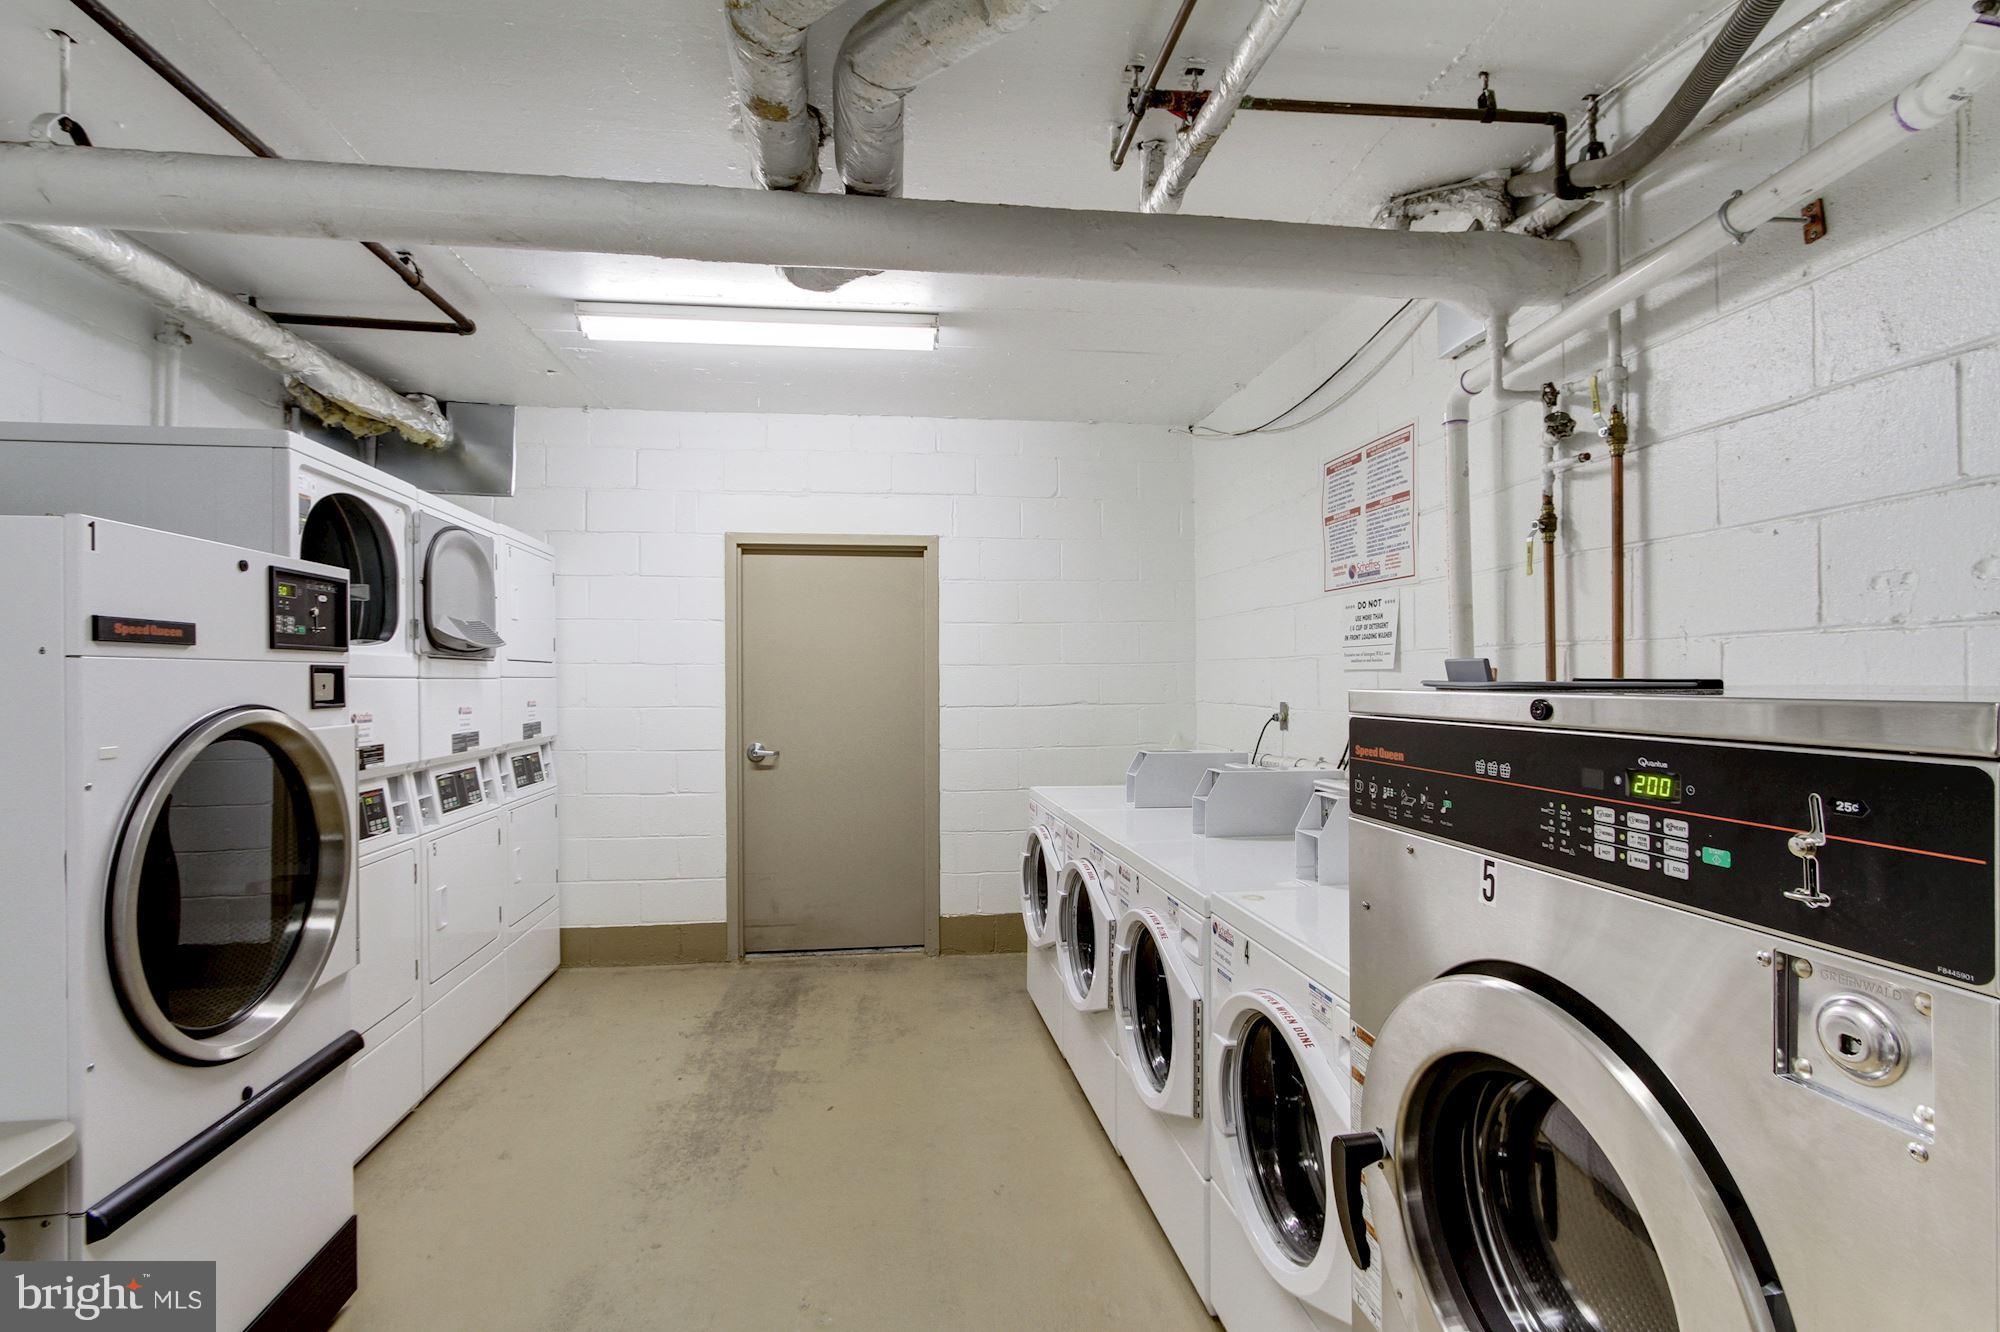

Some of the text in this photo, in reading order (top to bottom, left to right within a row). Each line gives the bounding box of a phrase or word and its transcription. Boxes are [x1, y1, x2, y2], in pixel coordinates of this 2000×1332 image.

[87, 521, 96, 551] 1
[1357, 598, 1382, 610] DO NOT
[113, 622, 183, 638] Speed Queen
[1354, 744, 1405, 761] Speed Queen
[1637, 757, 1668, 769] Quantum
[1633, 774, 1672, 798] 200
[1483, 859, 1495, 902] 5
[1672, 866, 1685, 874] COLD
[1244, 939, 1250, 965] 4
[1820, 969, 1904, 1002] GREENWALD
[1276, 1005, 1299, 1025] WHEN
[1293, 1026, 1317, 1050] DONE
